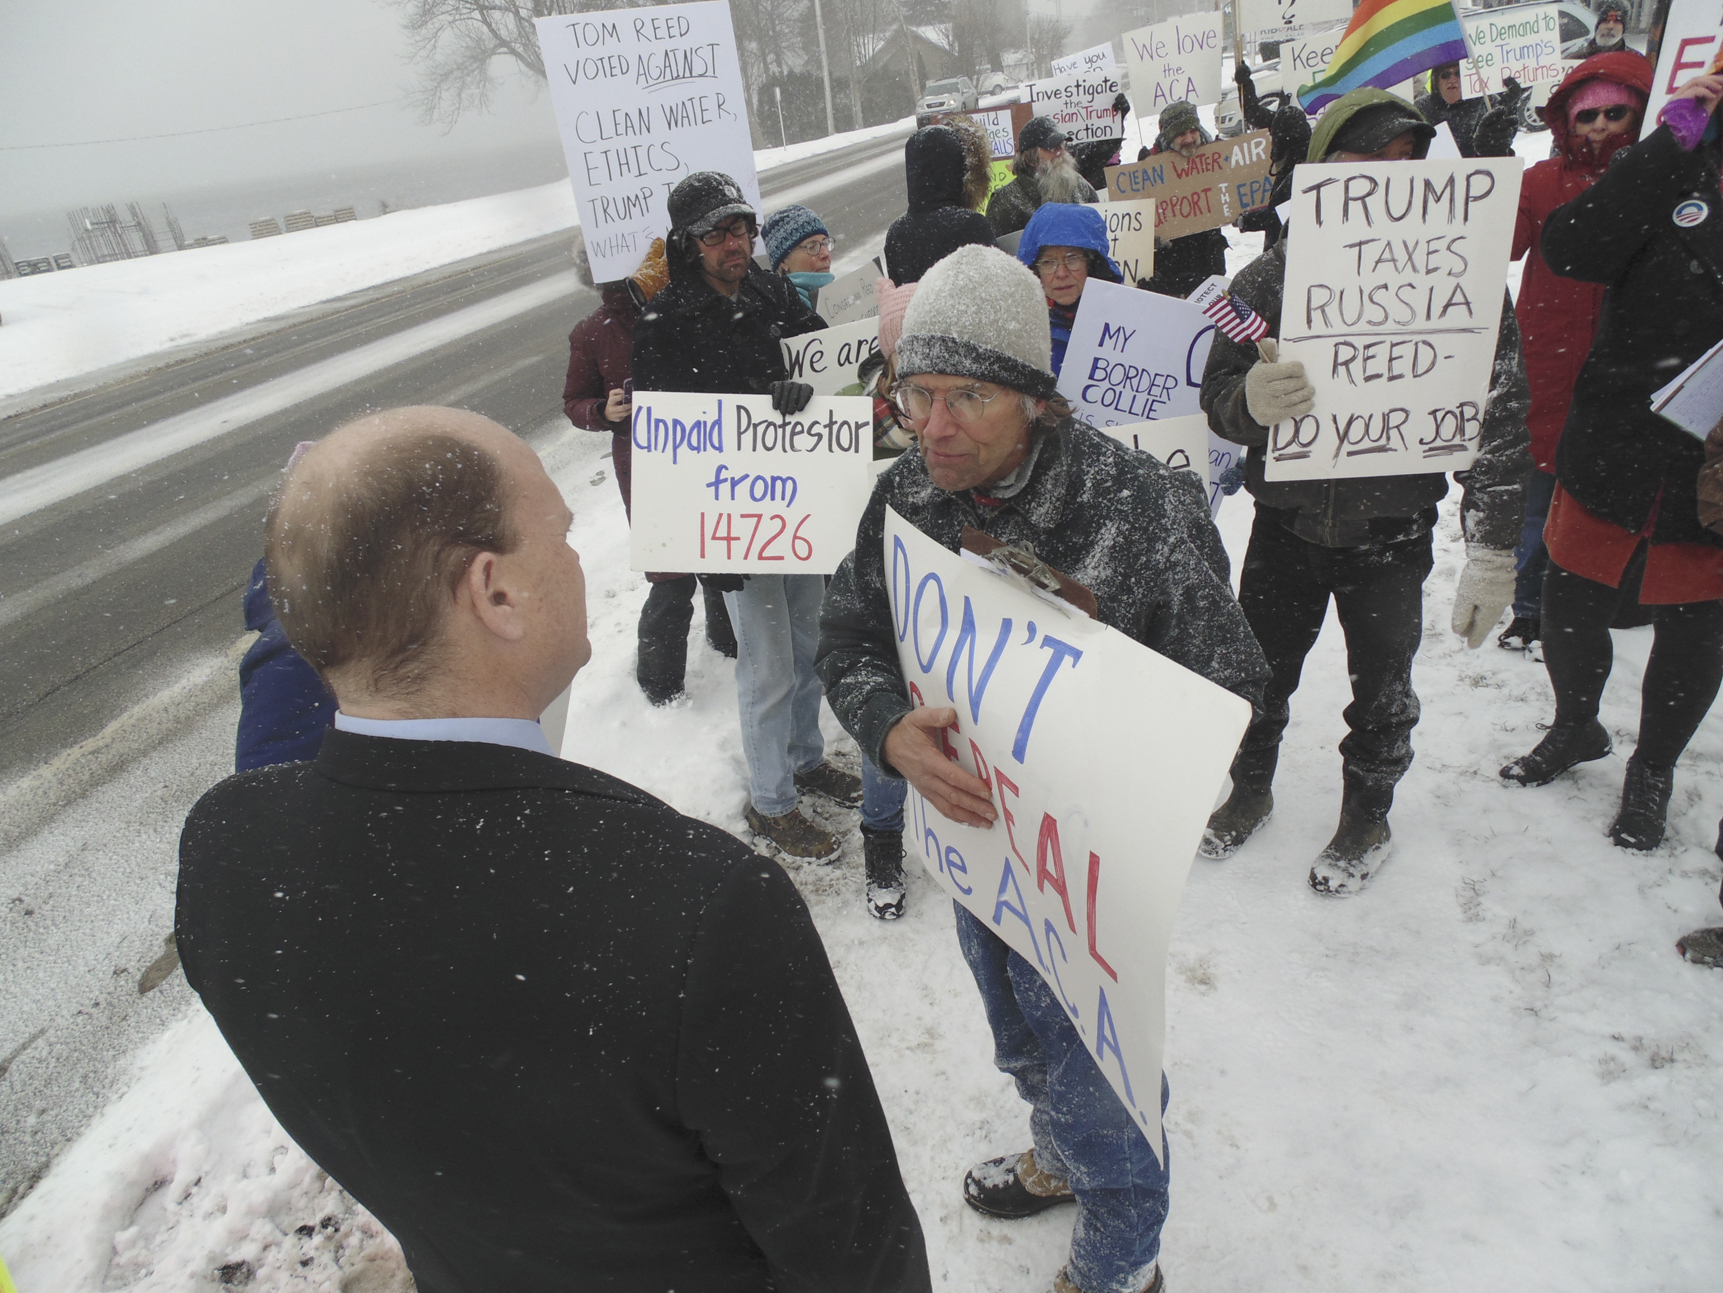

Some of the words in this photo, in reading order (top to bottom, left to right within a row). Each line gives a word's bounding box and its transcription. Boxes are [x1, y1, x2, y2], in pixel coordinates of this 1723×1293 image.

[566, 22, 621, 48] TOM
[633, 16, 690, 42] REED
[1131, 31, 1168, 62] We
[1176, 25, 1217, 55] love
[1489, 13, 1539, 43] Demand
[1541, 11, 1556, 32] to
[564, 54, 629, 85] VOTED
[636, 43, 720, 85] AGAINST
[1052, 61, 1078, 76] Have
[1084, 52, 1106, 69] you
[1163, 63, 1185, 78] the
[1292, 43, 1338, 71] Kee
[1495, 39, 1555, 66] Trump's
[1025, 76, 1118, 103] Investigate
[1154, 76, 1199, 107] ACA
[1464, 72, 1490, 94] Tax
[1501, 63, 1559, 88] Returns
[576, 106, 651, 144] CLEAN
[661, 93, 737, 131] WATER,
[1063, 100, 1082, 109] the
[988, 127, 1009, 140] ges
[992, 138, 1014, 155] ALLS
[1067, 123, 1113, 140] ection
[584, 141, 689, 187] ETHICS,
[1116, 164, 1165, 194] CLEAN
[1170, 151, 1223, 179] WATER
[1231, 138, 1266, 168] AIR
[588, 186, 653, 228] TRUMP
[1218, 182, 1232, 217] THE
[1236, 175, 1274, 209] EPA
[1302, 169, 1494, 228] TRUMP
[1104, 209, 1142, 233] ions
[1343, 235, 1468, 277] TAXES
[1306, 282, 1473, 330] RUSSIA
[1098, 322, 1136, 353] MY
[784, 338, 827, 380] We
[1088, 357, 1178, 401] BORDER
[1081, 384, 1167, 421] COLLIE
[633, 399, 723, 464] Unpaid
[736, 405, 869, 453] Protestor
[1272, 414, 1320, 453] DO
[1332, 407, 1411, 468] YOUR
[1419, 401, 1482, 446] JOB
[706, 464, 798, 508] from
[700, 512, 813, 561] 14726
[893, 534, 1083, 764] DON'T
